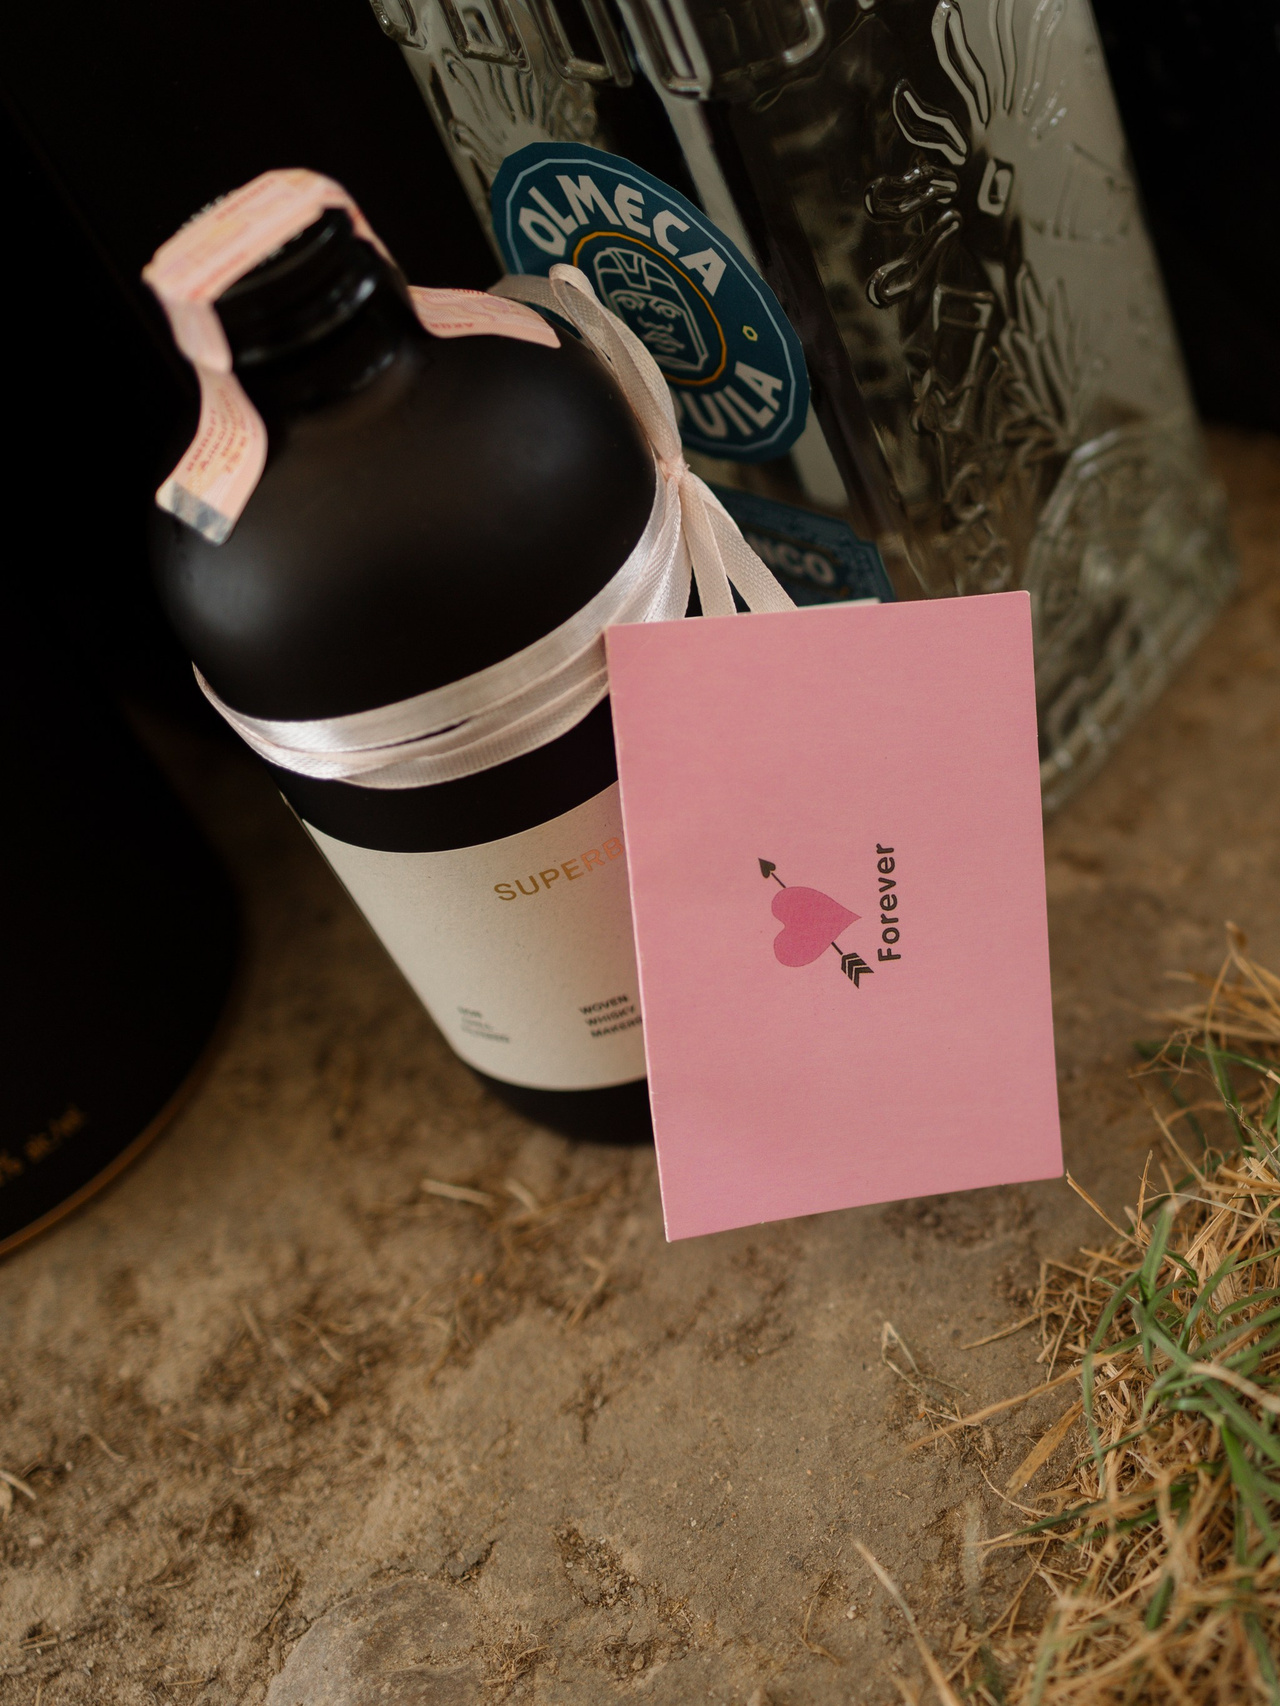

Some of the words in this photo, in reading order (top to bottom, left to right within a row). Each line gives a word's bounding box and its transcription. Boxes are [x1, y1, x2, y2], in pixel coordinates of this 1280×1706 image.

[518, 174, 727, 297] OLMECA
[677, 360, 783, 439] UILA
[493, 836, 626, 901] SUPERB
[876, 843, 902, 962] Forever
[578, 994, 629, 1015] WOVEN
[585, 1004, 635, 1026] WHISKY
